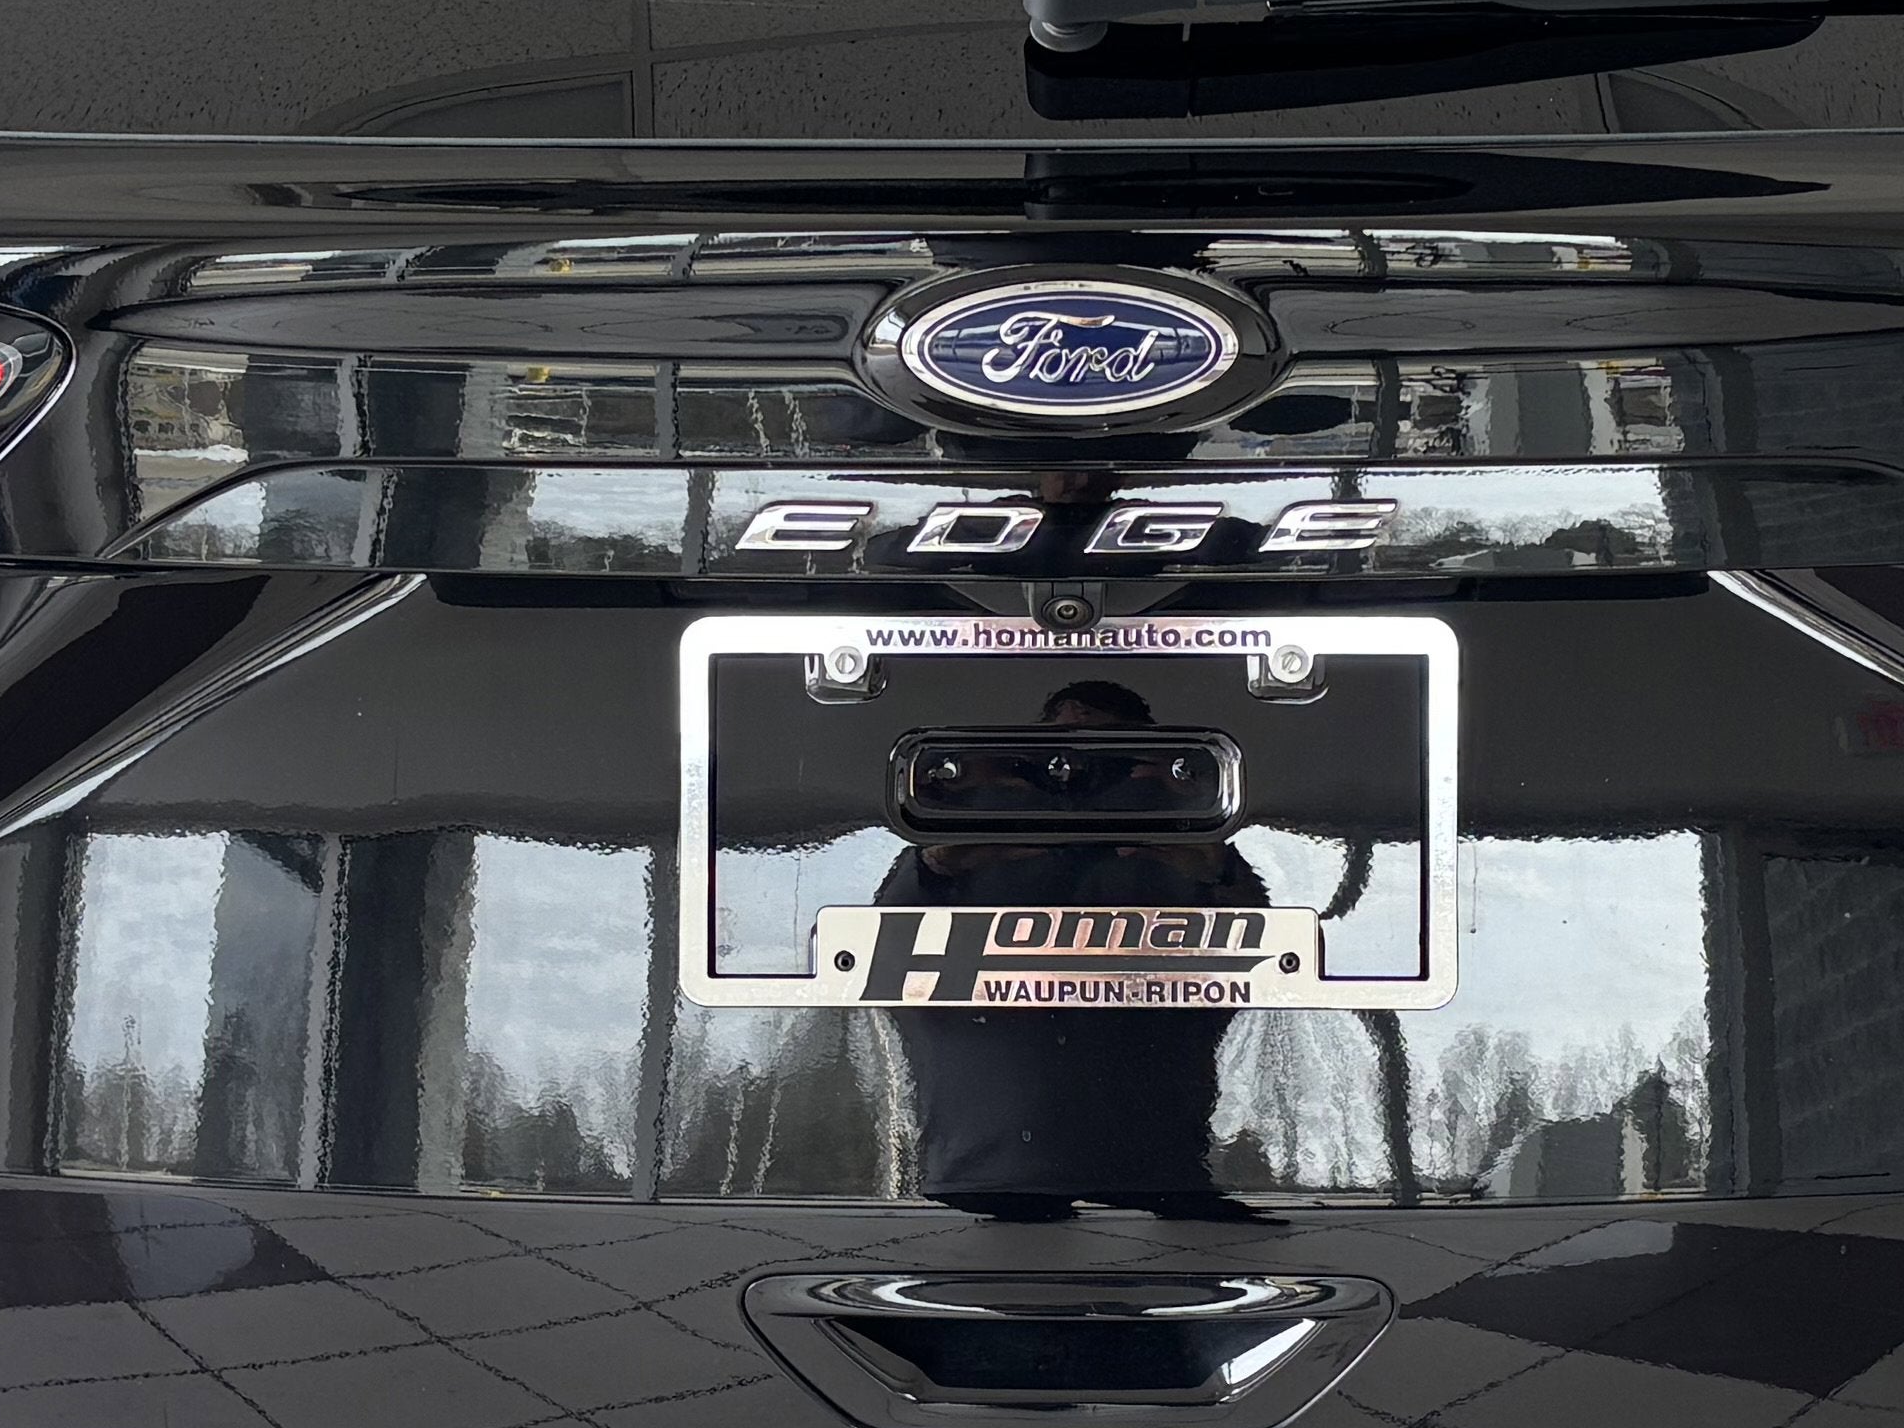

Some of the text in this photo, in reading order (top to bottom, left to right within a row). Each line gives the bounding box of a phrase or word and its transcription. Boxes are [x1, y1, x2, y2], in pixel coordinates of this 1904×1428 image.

[981, 310, 1159, 383] Ford
[735, 500, 1397, 553] EDGE
[865, 622, 1271, 648] www.homanauto.com
[859, 911, 1266, 1001] Homan
[982, 979, 1251, 1003] WAUPUN-RIPON
